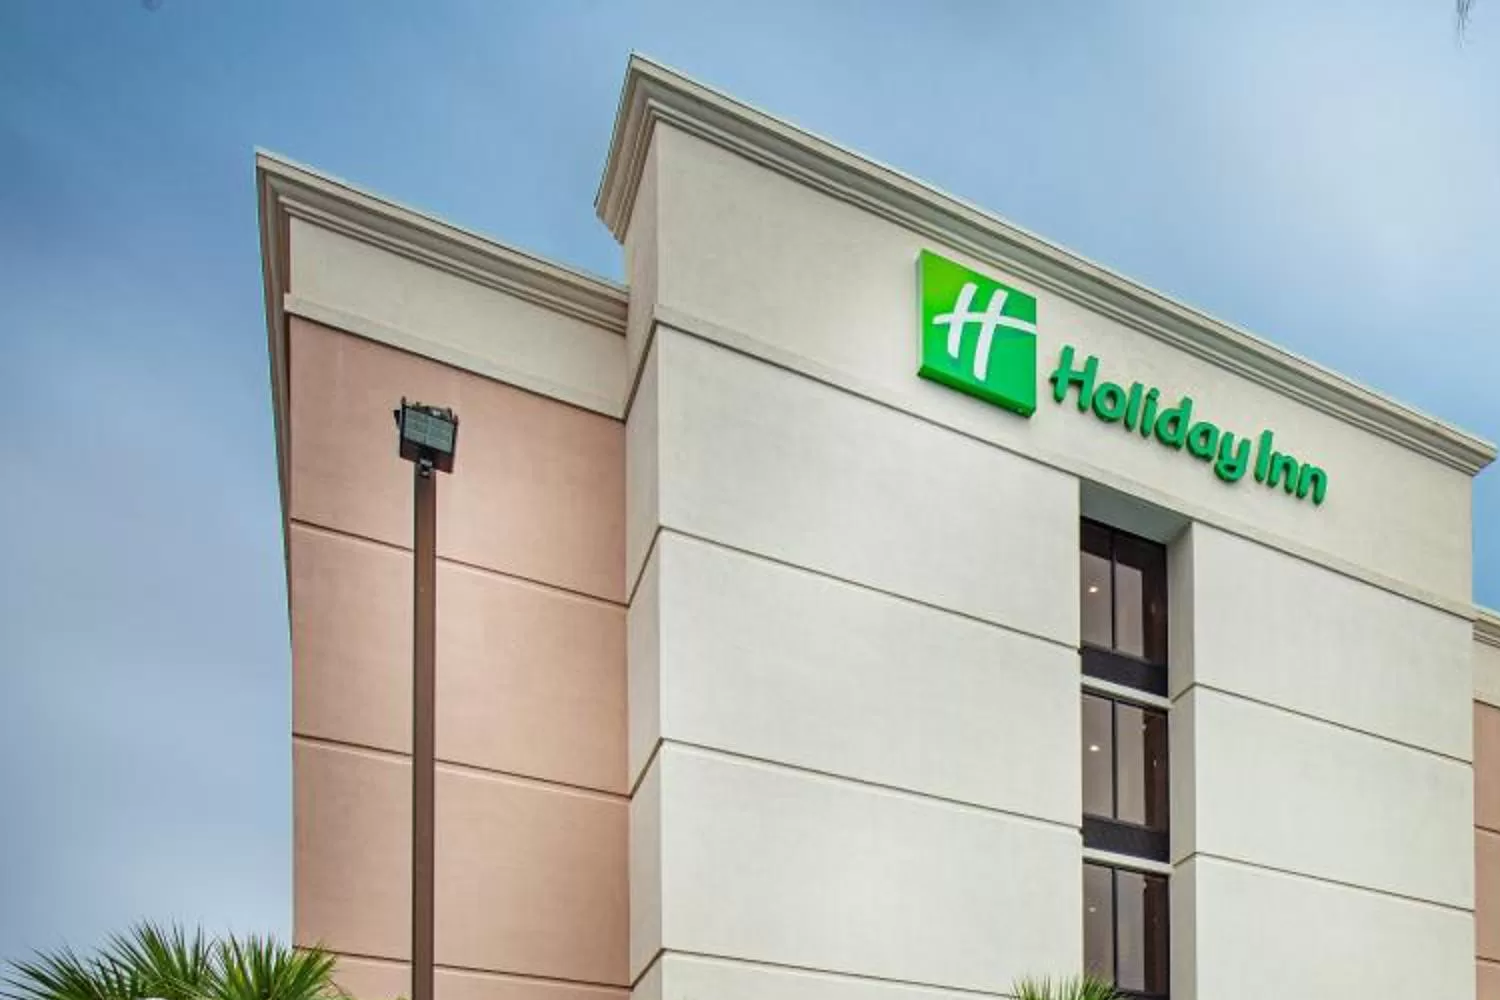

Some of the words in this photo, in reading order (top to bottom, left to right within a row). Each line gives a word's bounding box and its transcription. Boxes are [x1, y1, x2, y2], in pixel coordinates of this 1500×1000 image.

[932, 282, 1036, 381] H
[1050, 344, 1251, 482] Holiday
[1254, 429, 1328, 504] Inn
